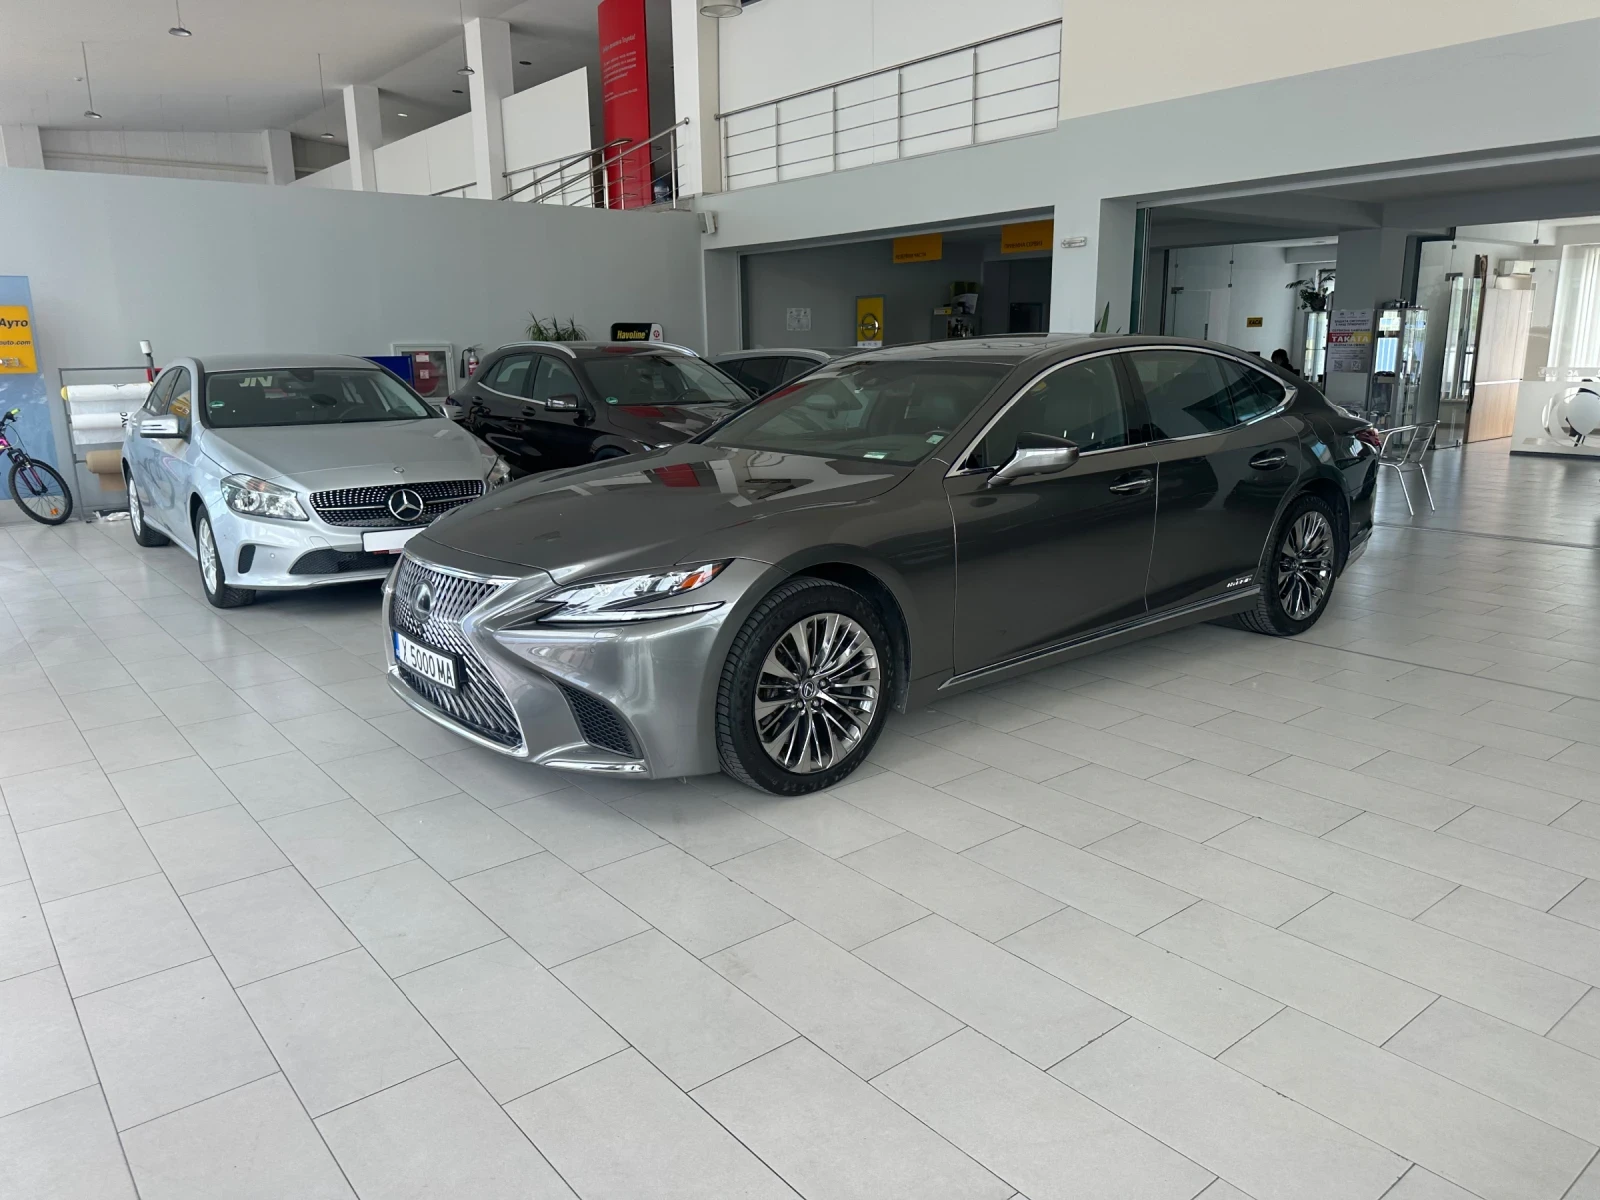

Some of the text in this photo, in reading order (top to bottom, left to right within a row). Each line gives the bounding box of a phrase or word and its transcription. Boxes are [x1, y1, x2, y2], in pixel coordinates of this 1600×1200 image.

[617, 330, 645, 339] Havoline
[402, 638, 454, 686] X 5000 MA
